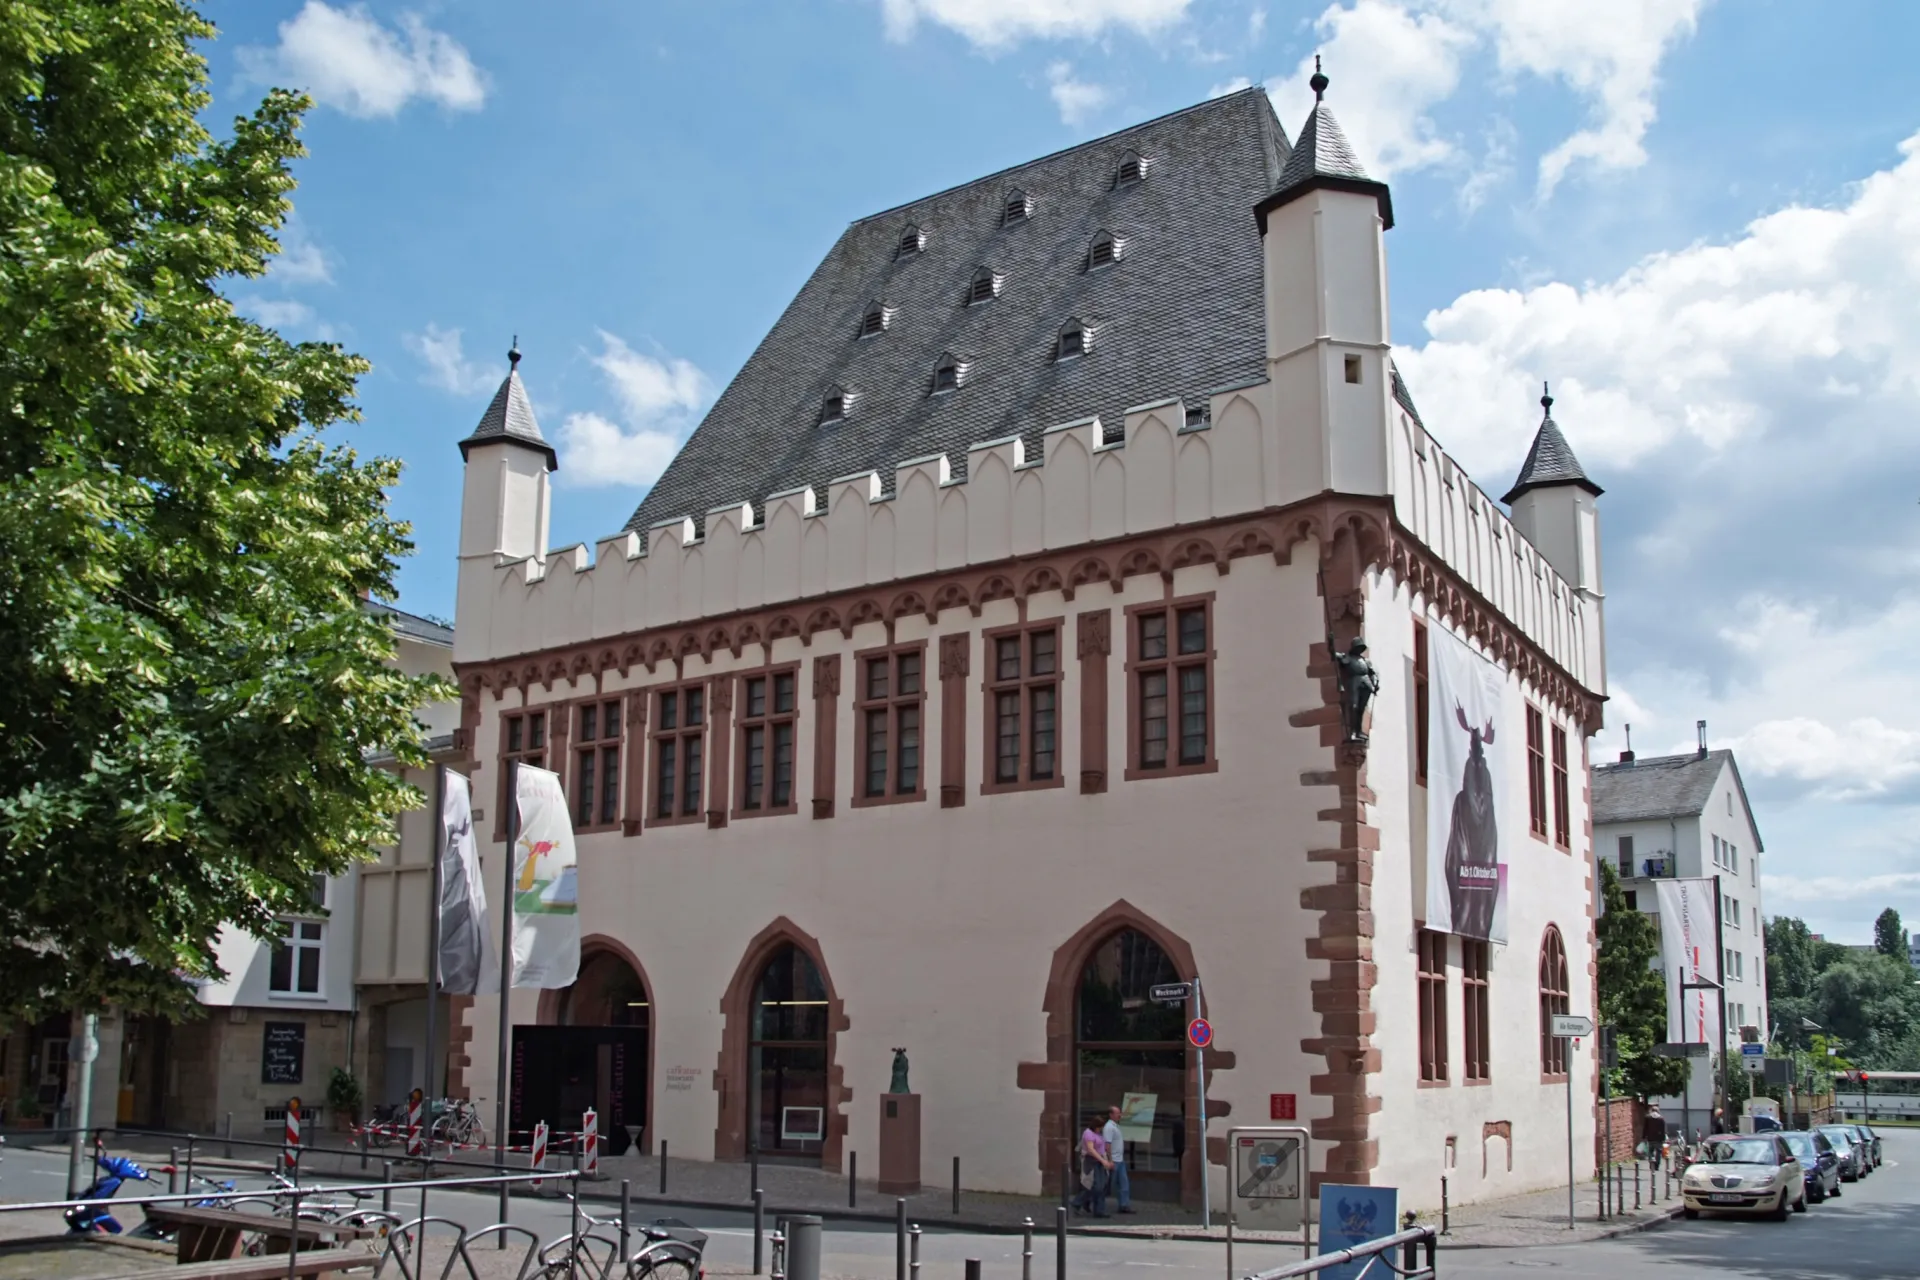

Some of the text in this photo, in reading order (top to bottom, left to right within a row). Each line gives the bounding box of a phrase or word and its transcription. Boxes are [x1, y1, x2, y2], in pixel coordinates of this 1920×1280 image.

[1460, 865, 1469, 877] Ab
[1155, 988, 1184, 996] Weckmarkt
[666, 1065, 702, 1074] caricatura
[511, 1040, 525, 1124] caricatura
[611, 1043, 624, 1127] caricatura
